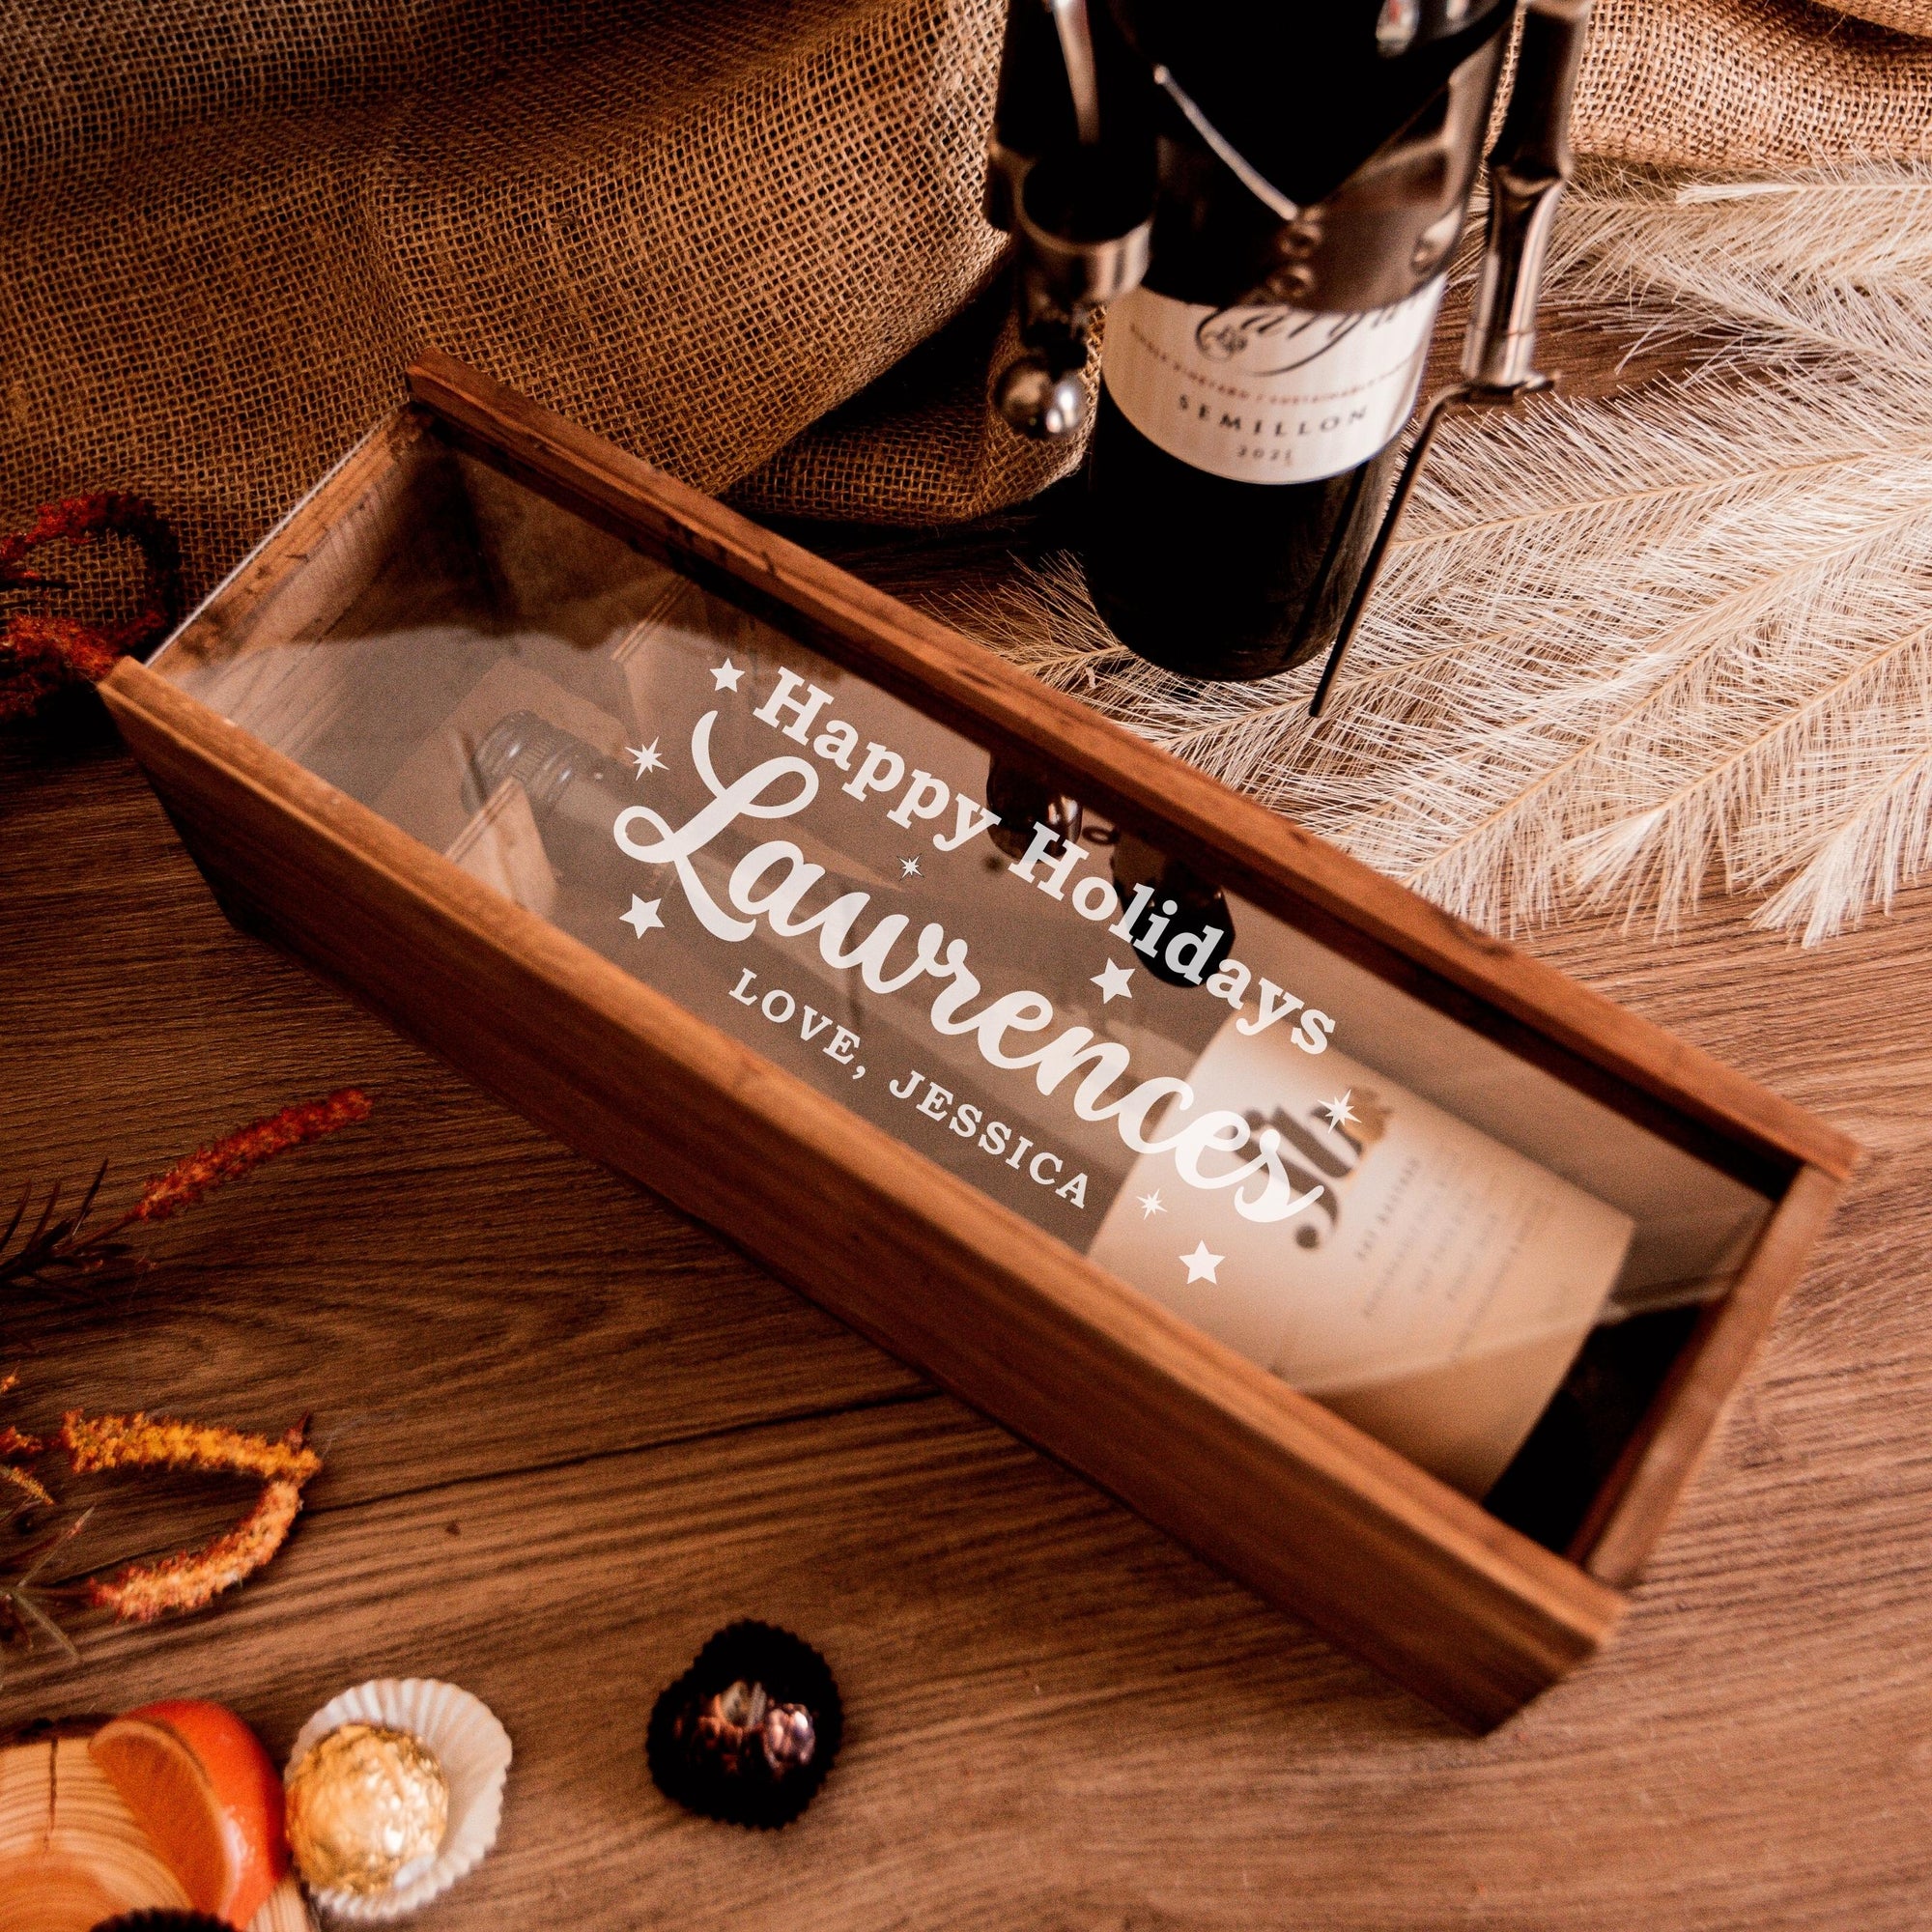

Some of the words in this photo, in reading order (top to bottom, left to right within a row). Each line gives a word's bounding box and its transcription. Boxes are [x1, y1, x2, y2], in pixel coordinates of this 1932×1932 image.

[1179, 394, 1368, 438] SEMILLON
[612, 710, 1324, 1224] Lawrences
[753, 667, 1002, 852] Happy
[1008, 821, 1338, 1056] Holidays
[728, 967, 867, 1080] LOVE,
[889, 1069, 1090, 1209] JESSICA
